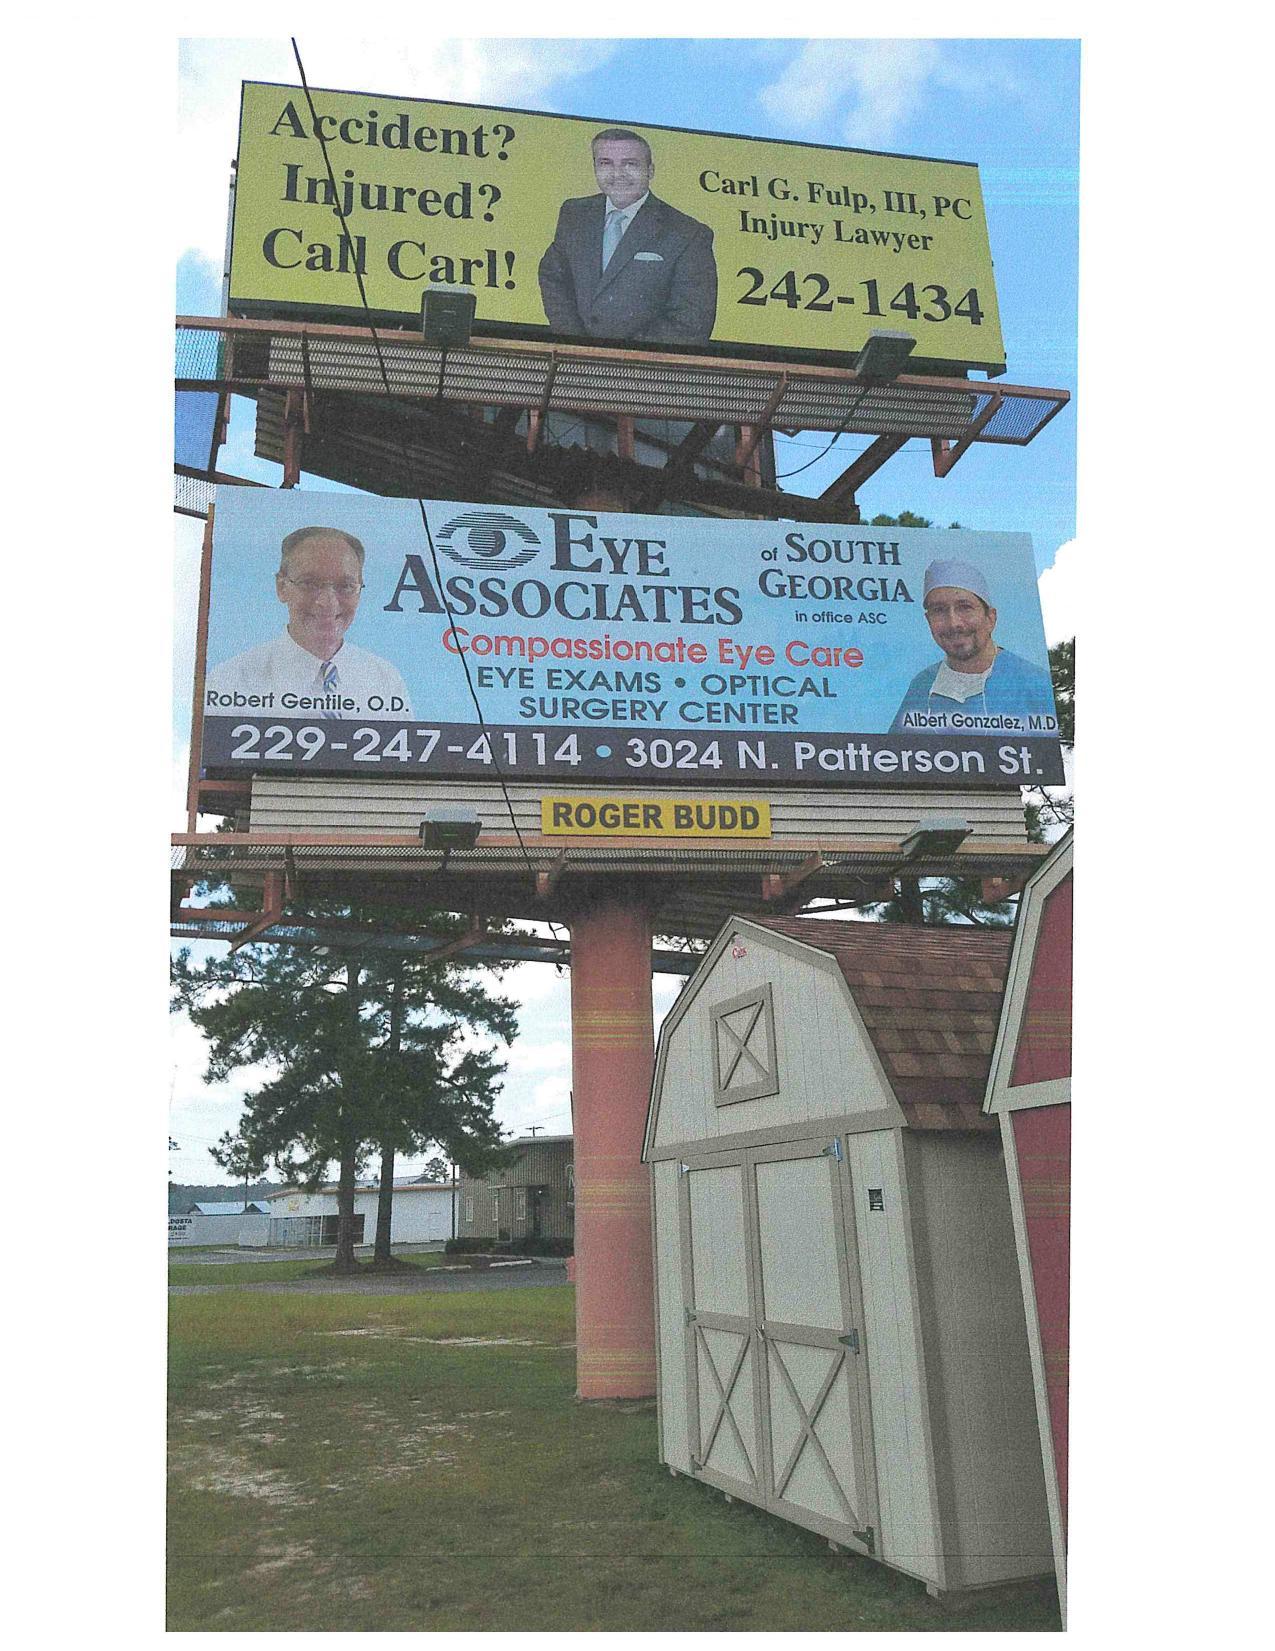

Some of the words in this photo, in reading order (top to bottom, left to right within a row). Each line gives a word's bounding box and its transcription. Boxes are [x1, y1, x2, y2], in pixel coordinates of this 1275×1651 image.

[270, 100, 516, 161] Accident?
[281, 163, 502, 222] Injured?
[699, 170, 759, 197] Carl
[768, 178, 799, 202] G.
[807, 182, 876, 213] Fulp,
[883, 192, 926, 220] III,
[933, 196, 973, 220] PC
[739, 211, 824, 244] Injury
[834, 220, 934, 253] Lawyer
[262, 227, 368, 275] Call
[387, 240, 516, 290] Carl!
[736, 267, 984, 325] 242-1434
[548, 513, 670, 577] EYE
[761, 546, 779, 561] of
[785, 532, 901, 566] SOUTH
[383, 554, 743, 626] ASSOCIATES
[758, 568, 915, 603] GEORGIA
[795, 610, 807, 623] in
[811, 610, 853, 624] office
[857, 612, 888, 625] ASC
[442, 627, 707, 664] Compassionate
[718, 639, 775, 670] Eye
[785, 640, 864, 668] Care
[206, 691, 275, 708] Robert
[281, 692, 360, 714] Gentile,
[368, 695, 409, 712] O.D.
[477, 666, 534, 689] EYE
[547, 667, 661, 694] EXAMS
[701, 673, 837, 698] OPTICAL
[519, 696, 668, 722] SURGERY
[679, 701, 799, 725] CENTER
[903, 712, 947, 727] Albert
[951, 713, 1025, 732] Gonzalez,
[231, 724, 582, 766] 229-247-4114
[625, 738, 722, 770] 3024
[738, 741, 778, 770] N.
[795, 742, 985, 773] Patterson
[999, 745, 1043, 775] St.
[553, 802, 661, 828] ROGER
[674, 806, 759, 830] BUDD
